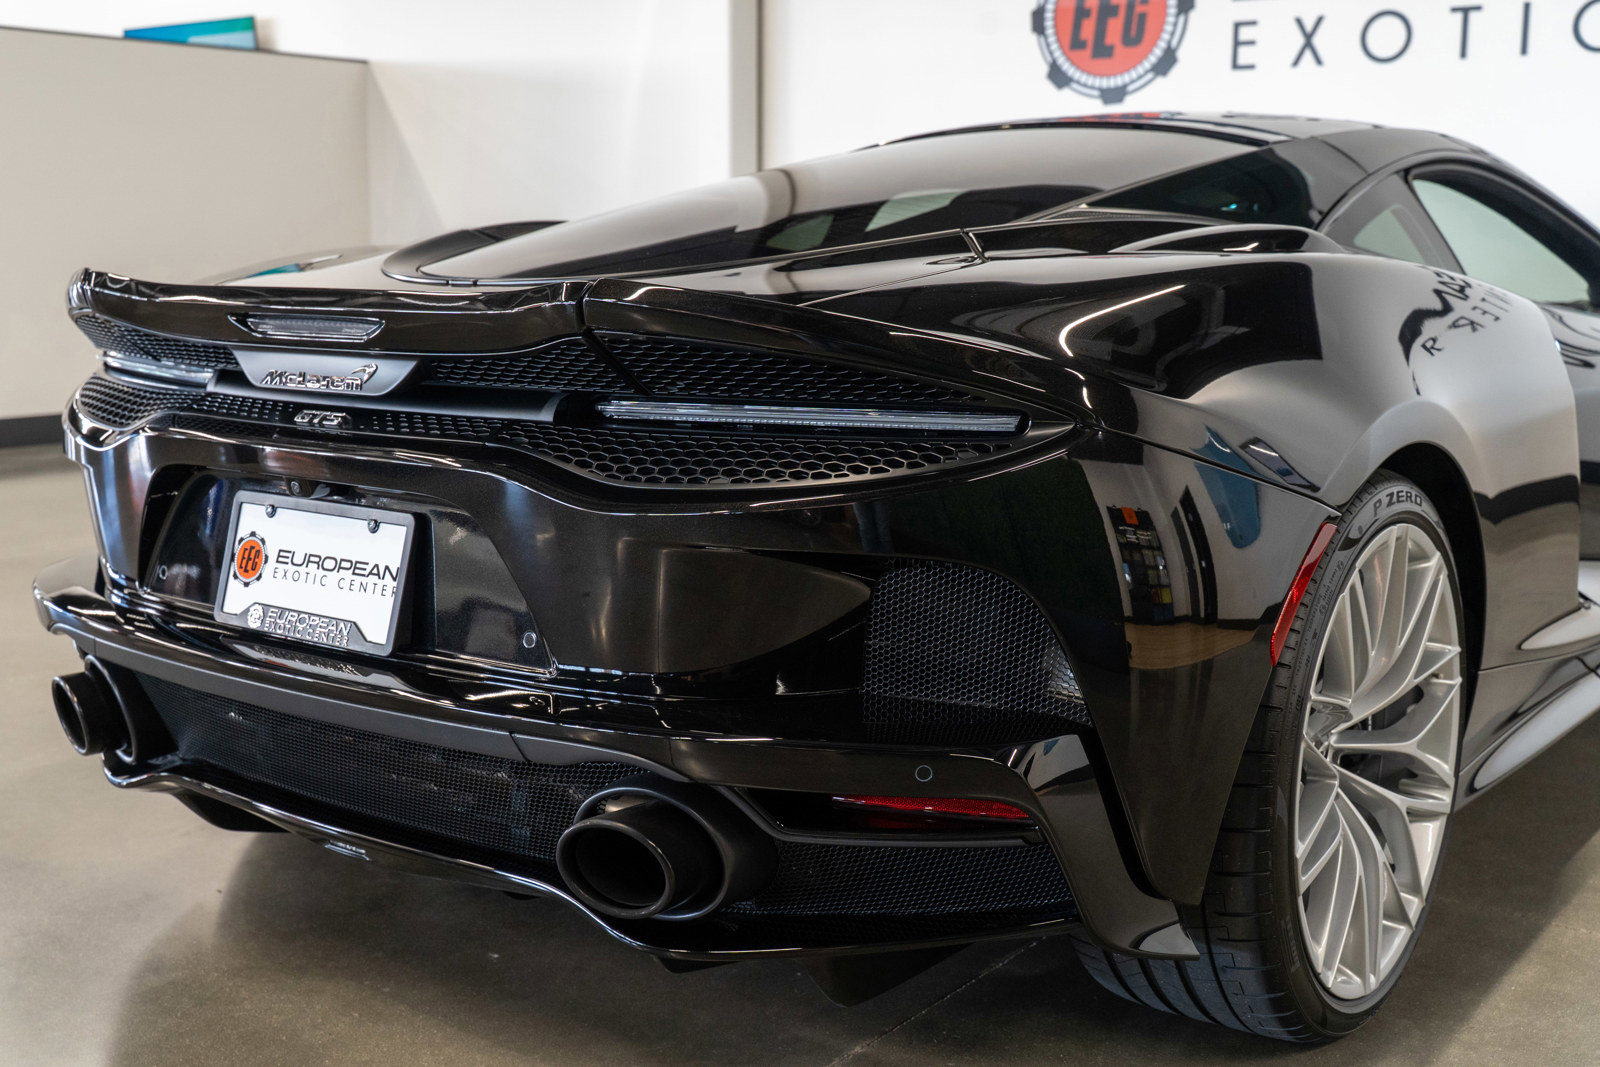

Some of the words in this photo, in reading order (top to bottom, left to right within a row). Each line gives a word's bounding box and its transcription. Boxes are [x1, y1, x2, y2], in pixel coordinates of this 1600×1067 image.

[261, 368, 364, 392] McLaren
[294, 409, 348, 426] GTS
[1373, 498, 1383, 518] P
[1385, 490, 1423, 508] ZERO
[272, 566, 328, 587] EXOTIC
[275, 549, 400, 582] EUROPEAN
[264, 620, 303, 637] EXOTIC
[306, 629, 349, 647] CENTER
[266, 608, 352, 636] EUROPEAN
